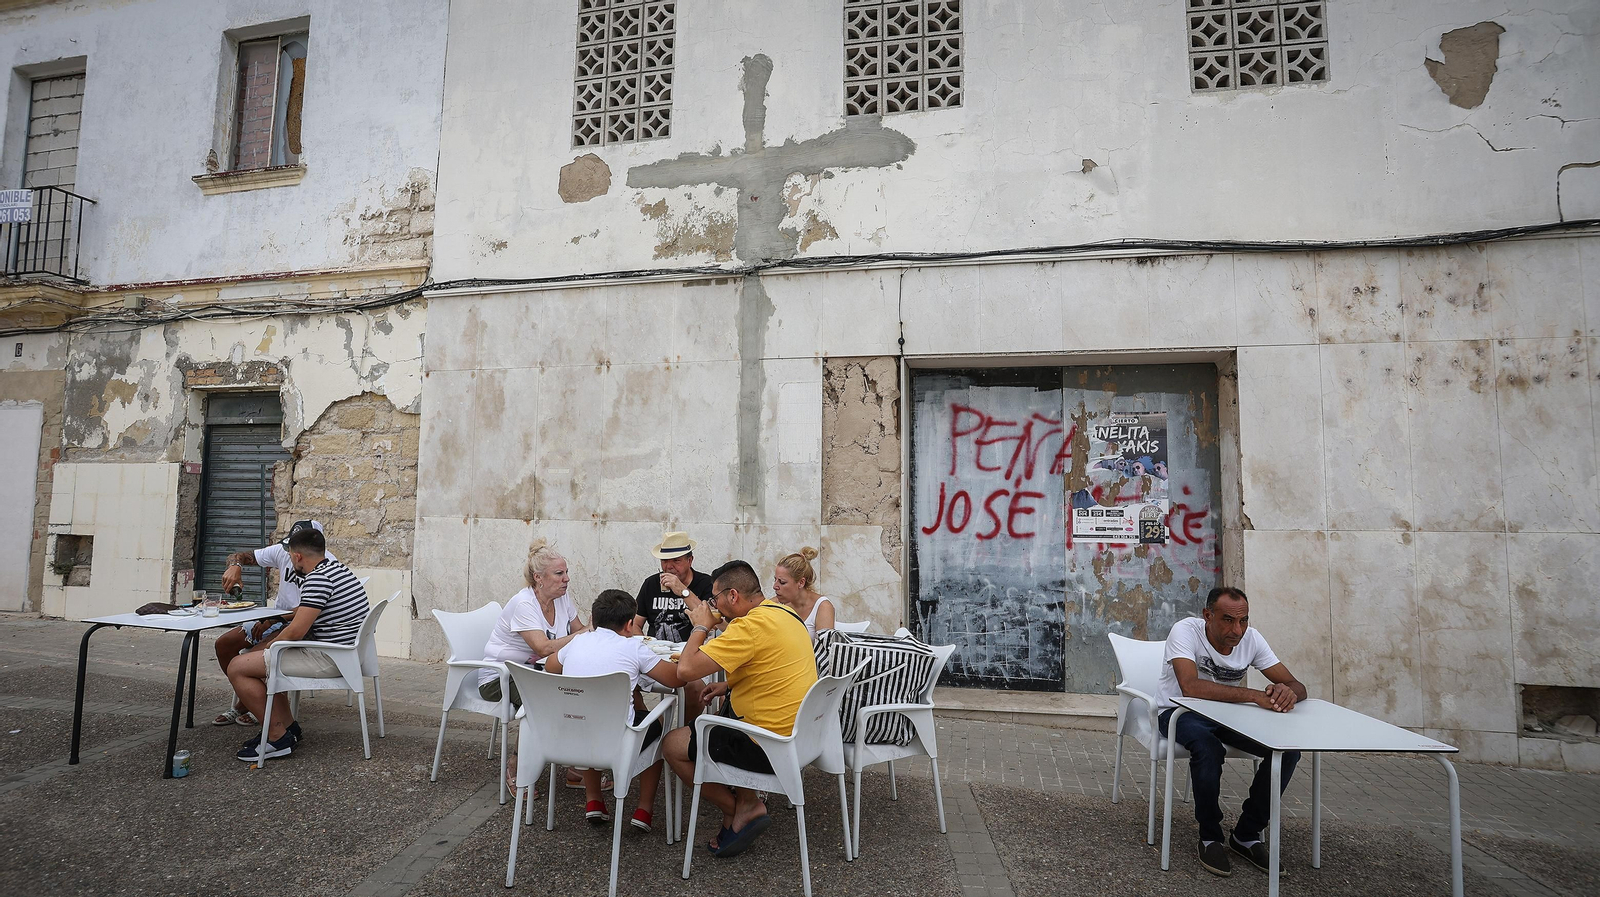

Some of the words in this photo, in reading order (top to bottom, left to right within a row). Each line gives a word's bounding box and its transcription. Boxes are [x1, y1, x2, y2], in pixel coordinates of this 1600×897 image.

[13, 208, 30, 221] 053
[16, 343, 22, 356] 6
[949, 402, 1078, 480] PEÑA
[921, 474, 1046, 541] JOSÉ
[1145, 526, 1160, 539] 29
[652, 597, 674, 609] LUIS
